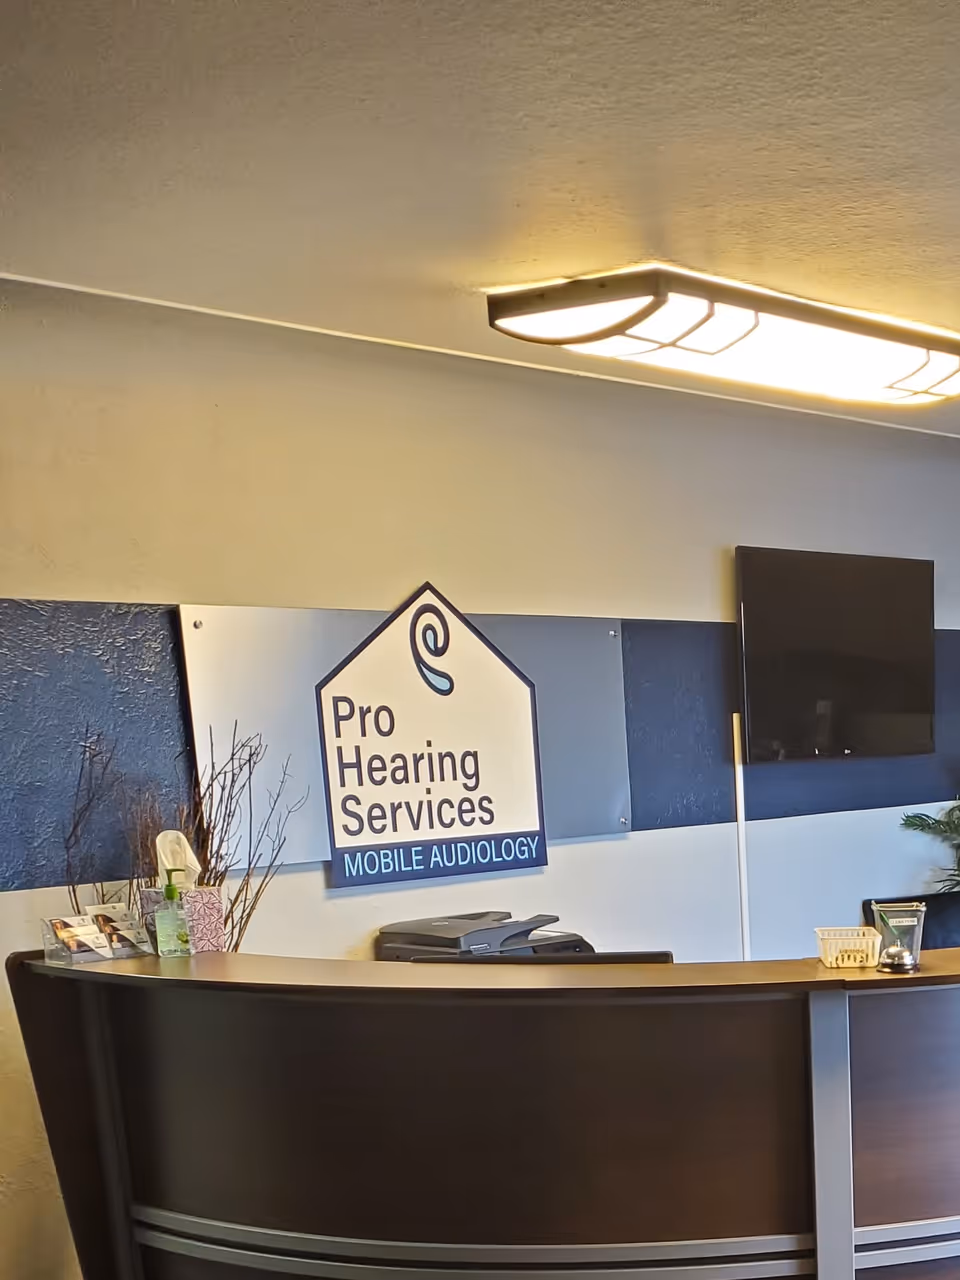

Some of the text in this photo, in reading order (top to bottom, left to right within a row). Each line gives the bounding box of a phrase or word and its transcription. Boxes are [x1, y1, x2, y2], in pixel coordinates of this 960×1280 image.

[332, 695, 396, 739] Pro
[336, 740, 480, 792] Hearing
[340, 787, 495, 837] Services
[344, 835, 539, 877] MOBILE AUDIOLOGY
